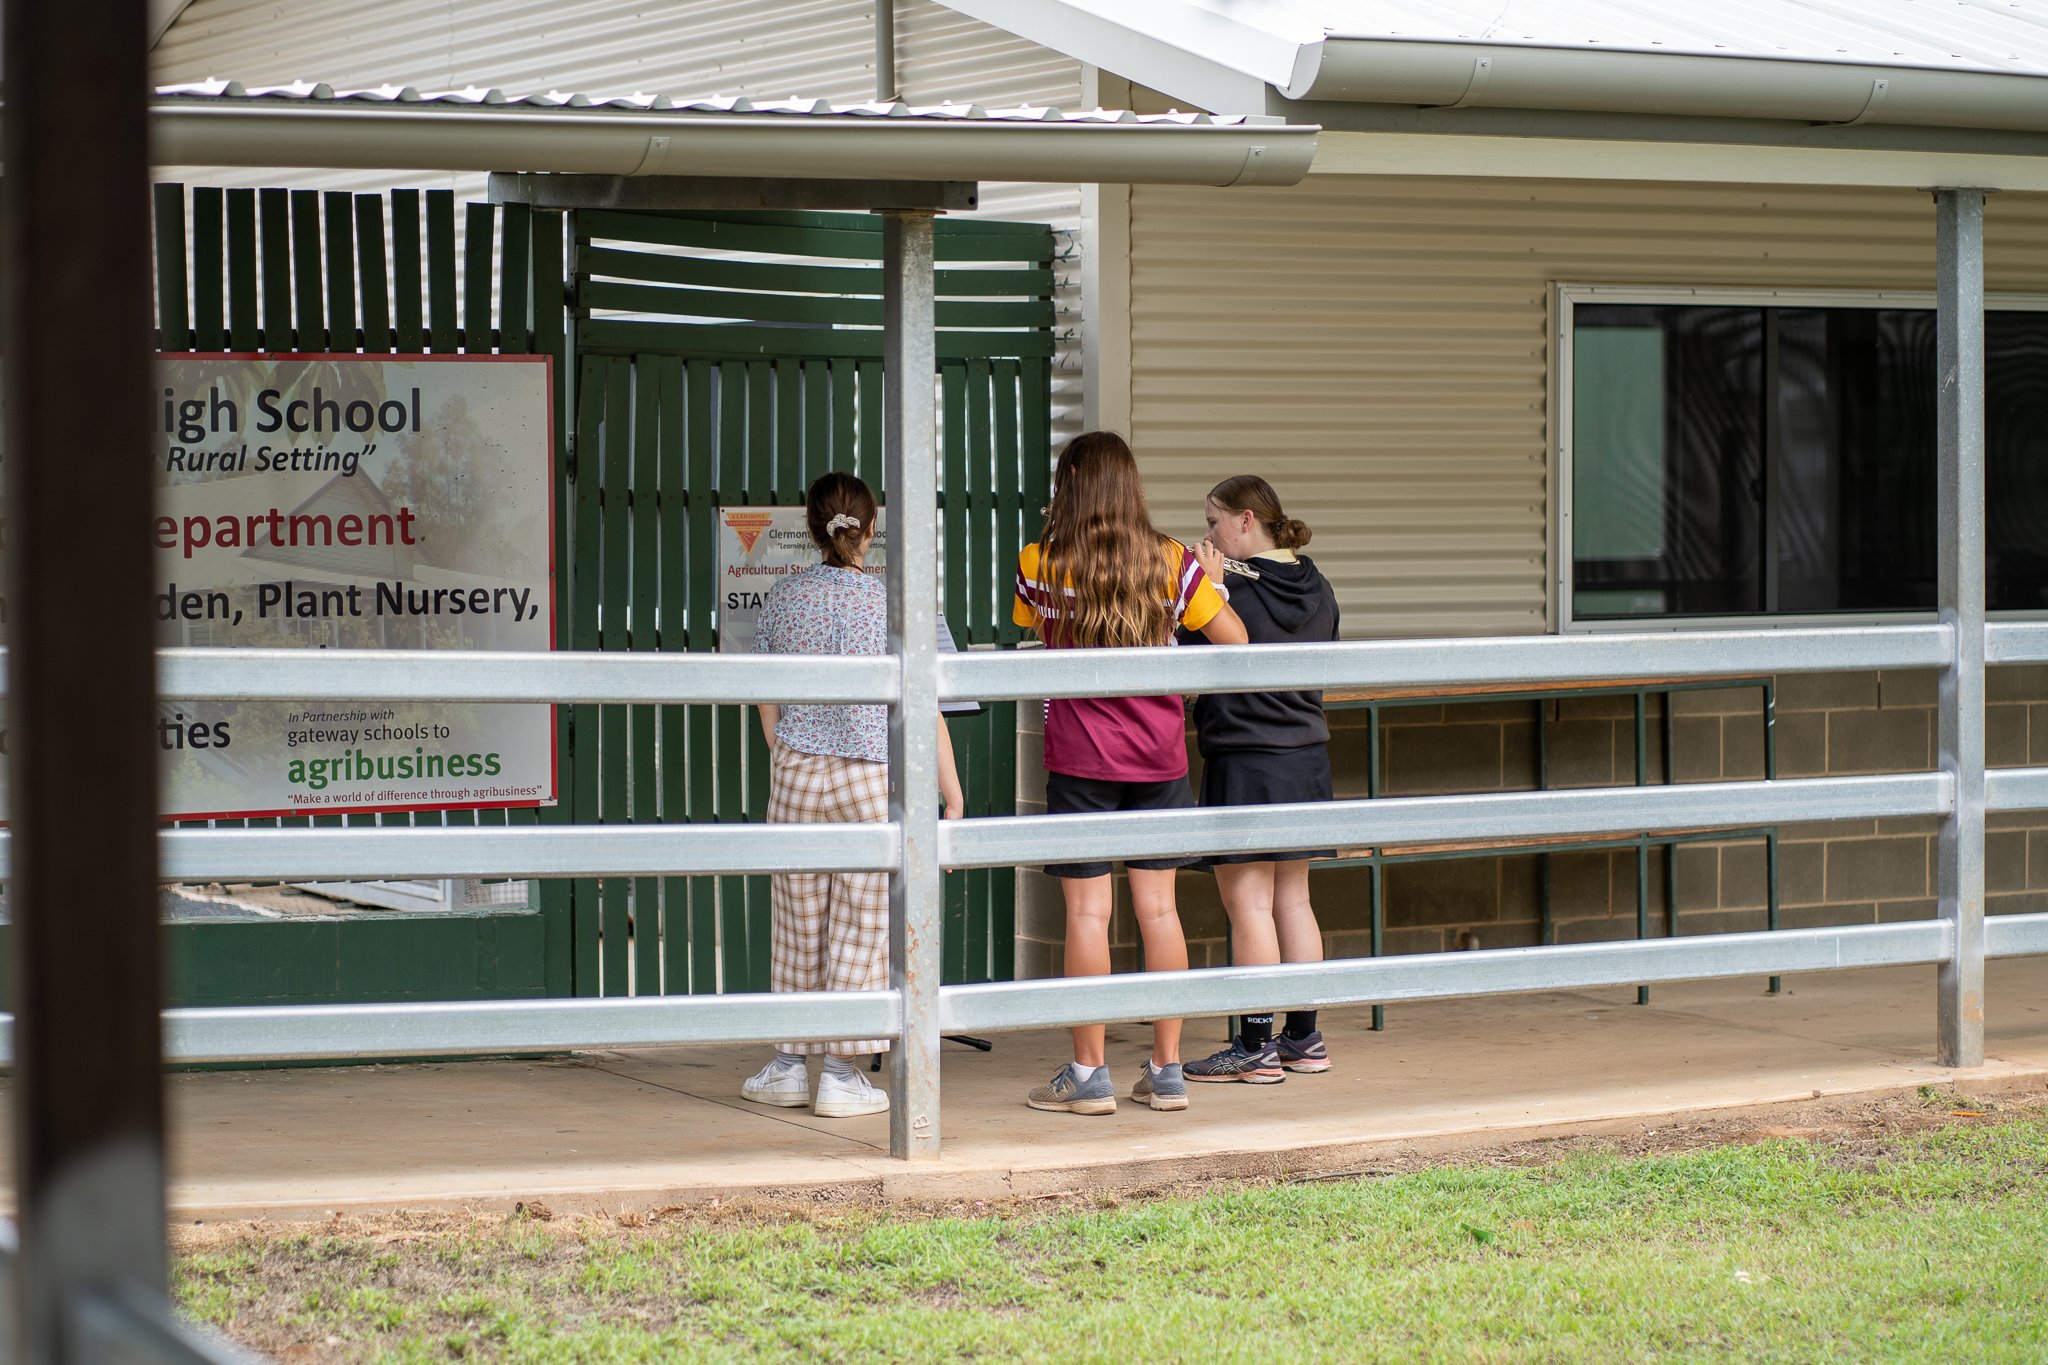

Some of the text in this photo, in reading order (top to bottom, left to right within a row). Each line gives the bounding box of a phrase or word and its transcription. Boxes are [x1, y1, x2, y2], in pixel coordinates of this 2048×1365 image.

[152, 387, 421, 444] igh School
[165, 443, 377, 477] Rural Setting”
[154, 506, 416, 559] epartment
[727, 564, 788, 577] Agricultural
[155, 579, 540, 626] den, Plant Nursery,
[157, 712, 231, 750] ties
[288, 708, 395, 723] In Partnership with
[287, 722, 450, 747] gateway schools to
[287, 747, 502, 790] agribusiness
[324, 796, 331, 804] a
[333, 791, 362, 803] world
[364, 791, 375, 802] of
[377, 788, 428, 801] difference
[430, 786, 471, 800] through
